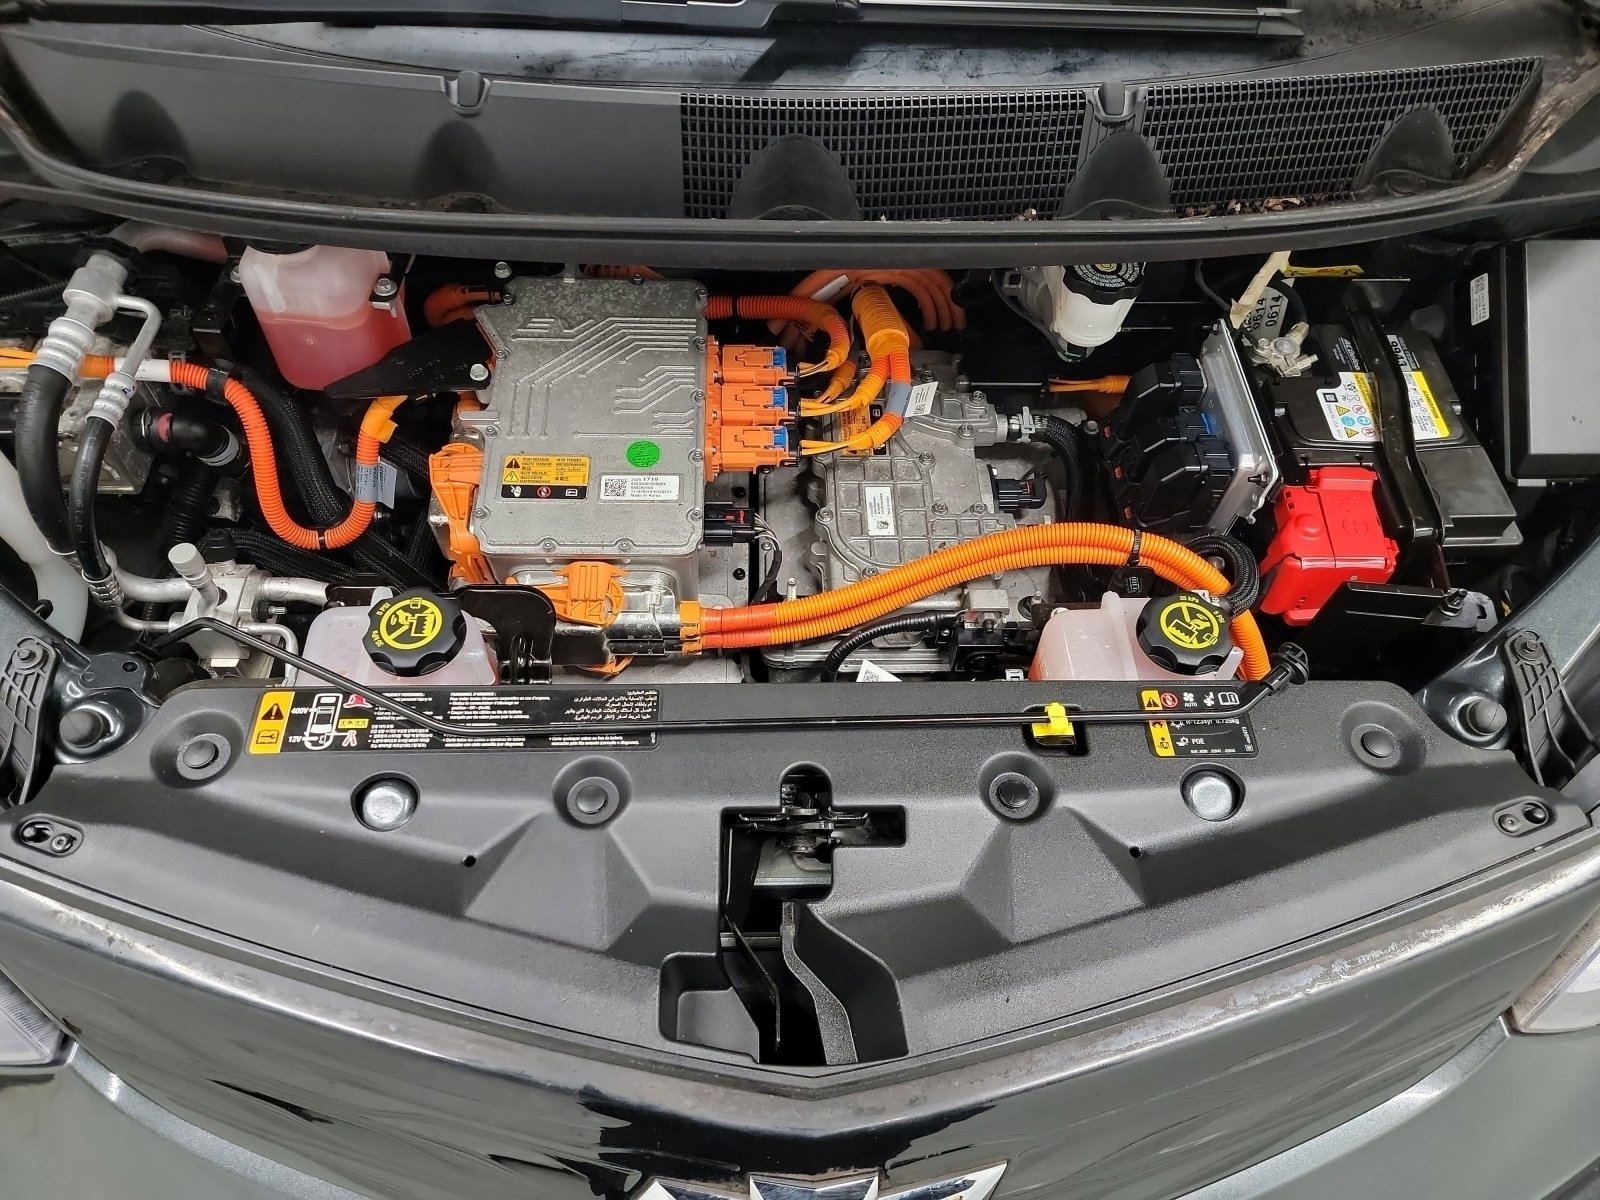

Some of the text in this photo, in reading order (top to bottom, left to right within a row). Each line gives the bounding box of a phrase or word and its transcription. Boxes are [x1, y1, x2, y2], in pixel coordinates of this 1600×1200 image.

[1252, 297, 1266, 330] 0614
[1265, 294, 1283, 328] 0614
[291, 707, 309, 715] 400V
[288, 735, 302, 743] 12V
